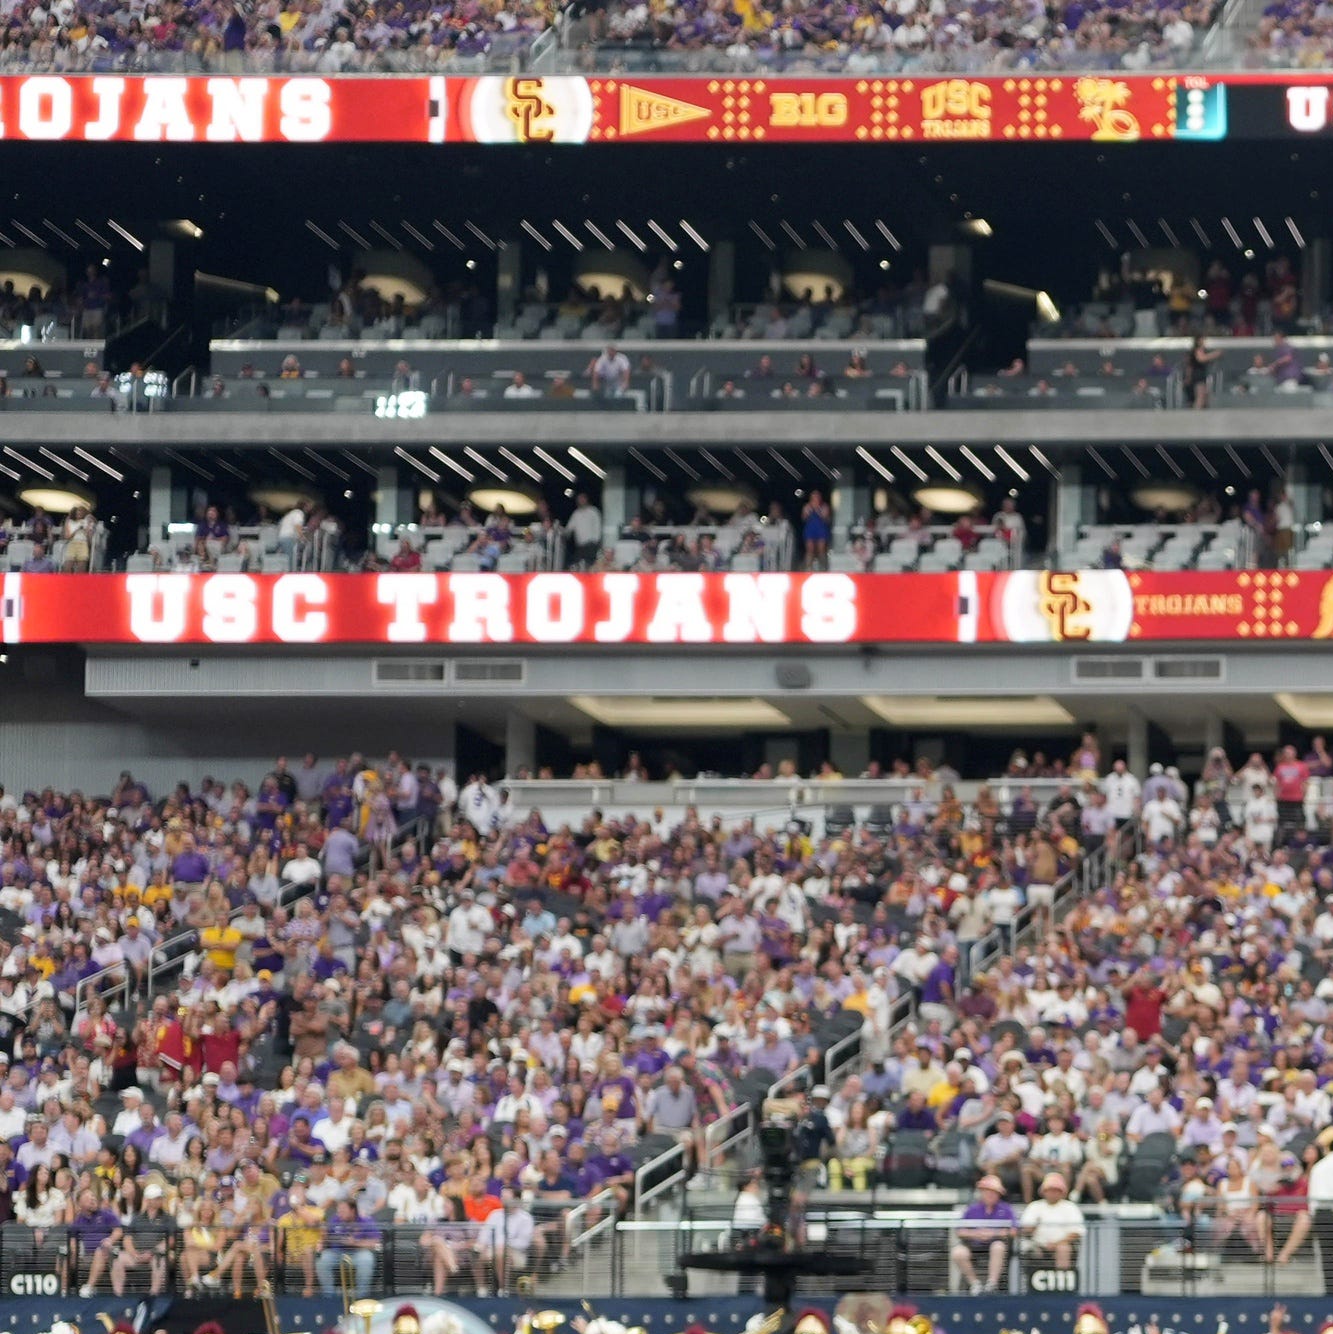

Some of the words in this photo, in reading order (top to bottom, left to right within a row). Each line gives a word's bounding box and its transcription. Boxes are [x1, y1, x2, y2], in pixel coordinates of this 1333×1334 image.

[0, 76, 333, 142] OJANS
[920, 79, 992, 119] USC
[126, 573, 329, 642] USC
[376, 573, 858, 642] TROJANS
[1134, 593, 1243, 615] TROJANS
[11, 1273, 58, 1296] C110
